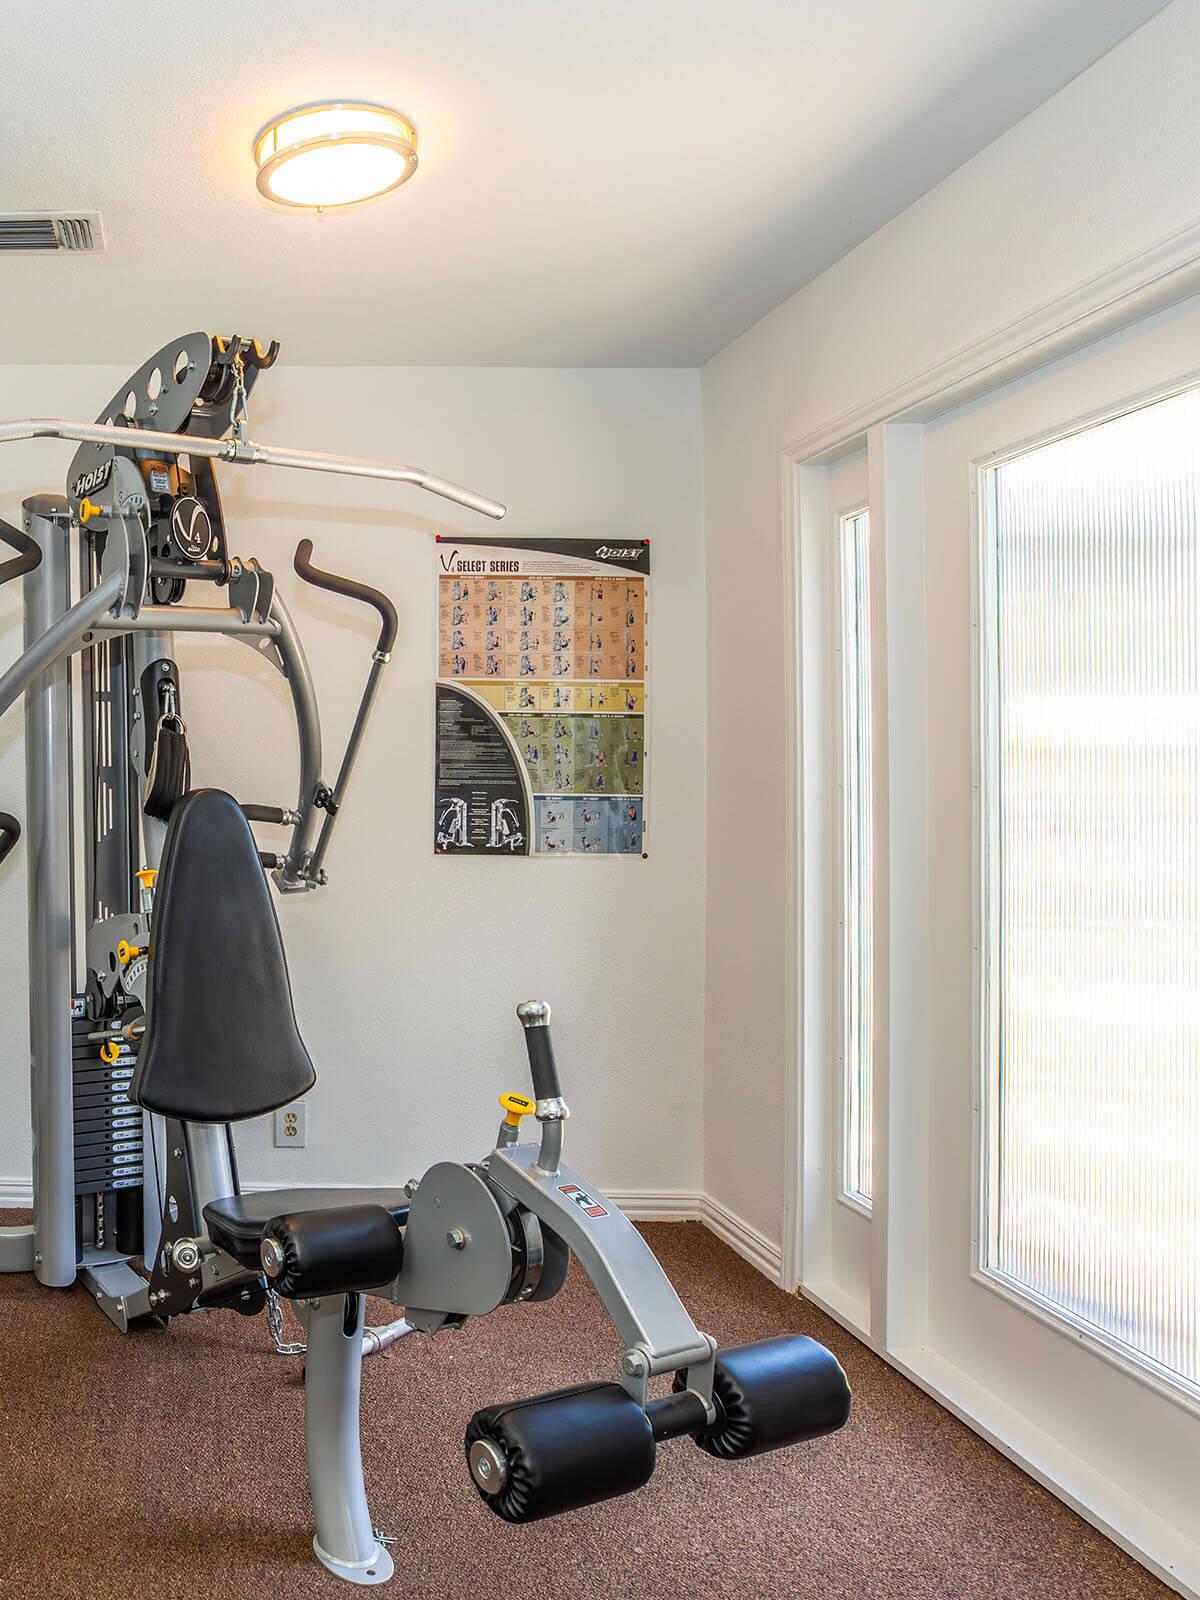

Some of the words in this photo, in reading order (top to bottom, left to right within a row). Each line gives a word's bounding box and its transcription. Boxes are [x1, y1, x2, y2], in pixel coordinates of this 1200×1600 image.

[75, 461, 112, 497] HOIST
[457, 560, 487, 572] SELECT
[490, 561, 519, 573] SERIES
